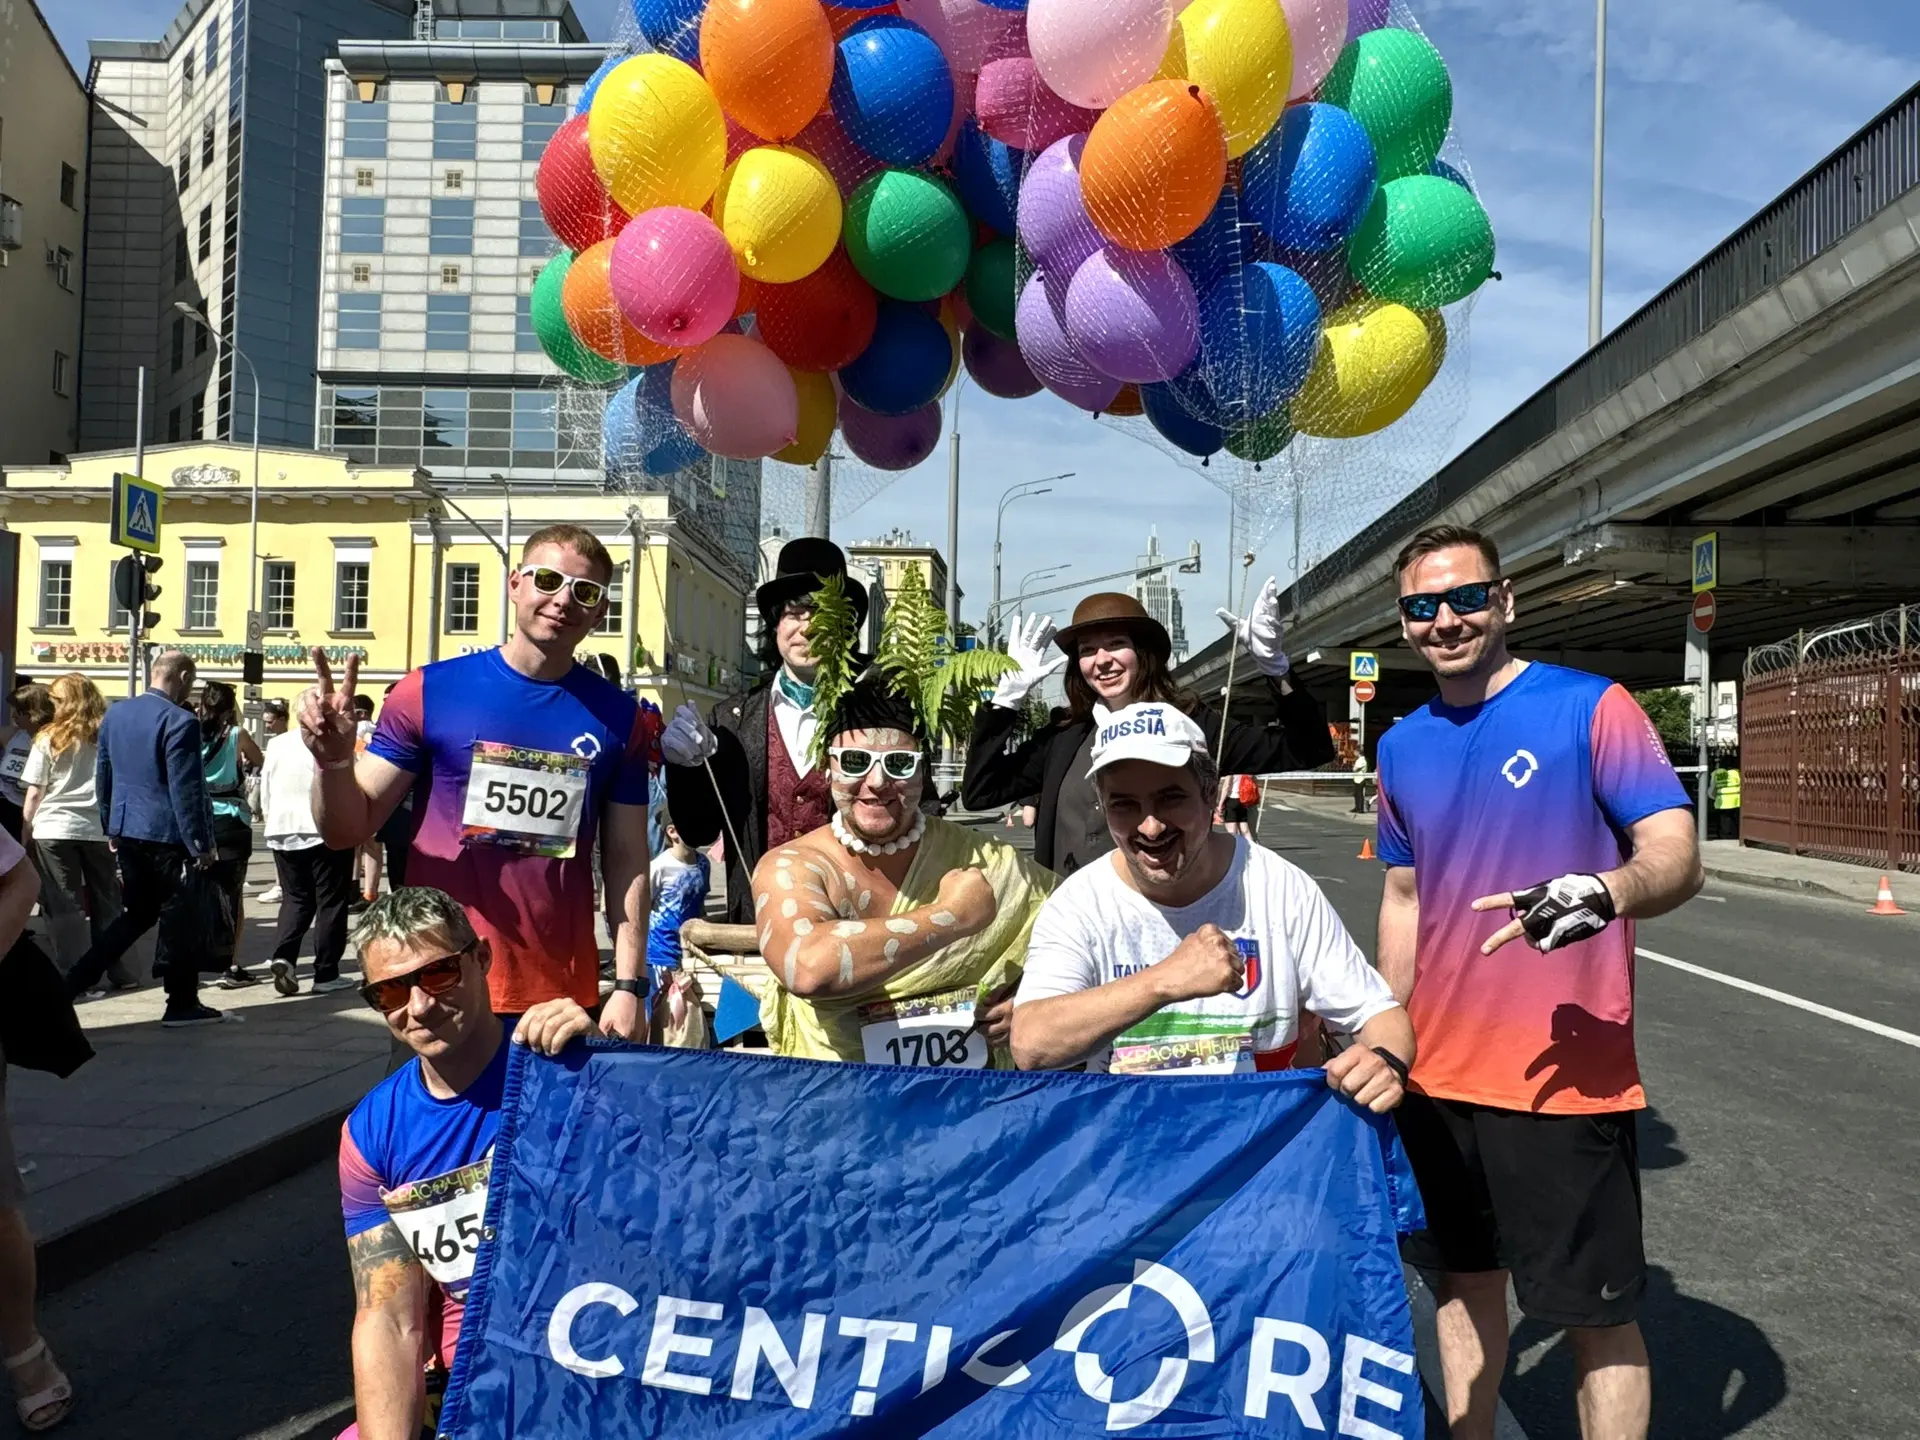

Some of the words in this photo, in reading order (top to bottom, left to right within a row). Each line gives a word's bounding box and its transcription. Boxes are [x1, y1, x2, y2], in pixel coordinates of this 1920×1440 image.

[1101, 718, 1166, 748] RUSSIA
[485, 780, 568, 821] 5502
[1113, 964, 1151, 979] ITAL
[412, 1213, 481, 1265] 465
